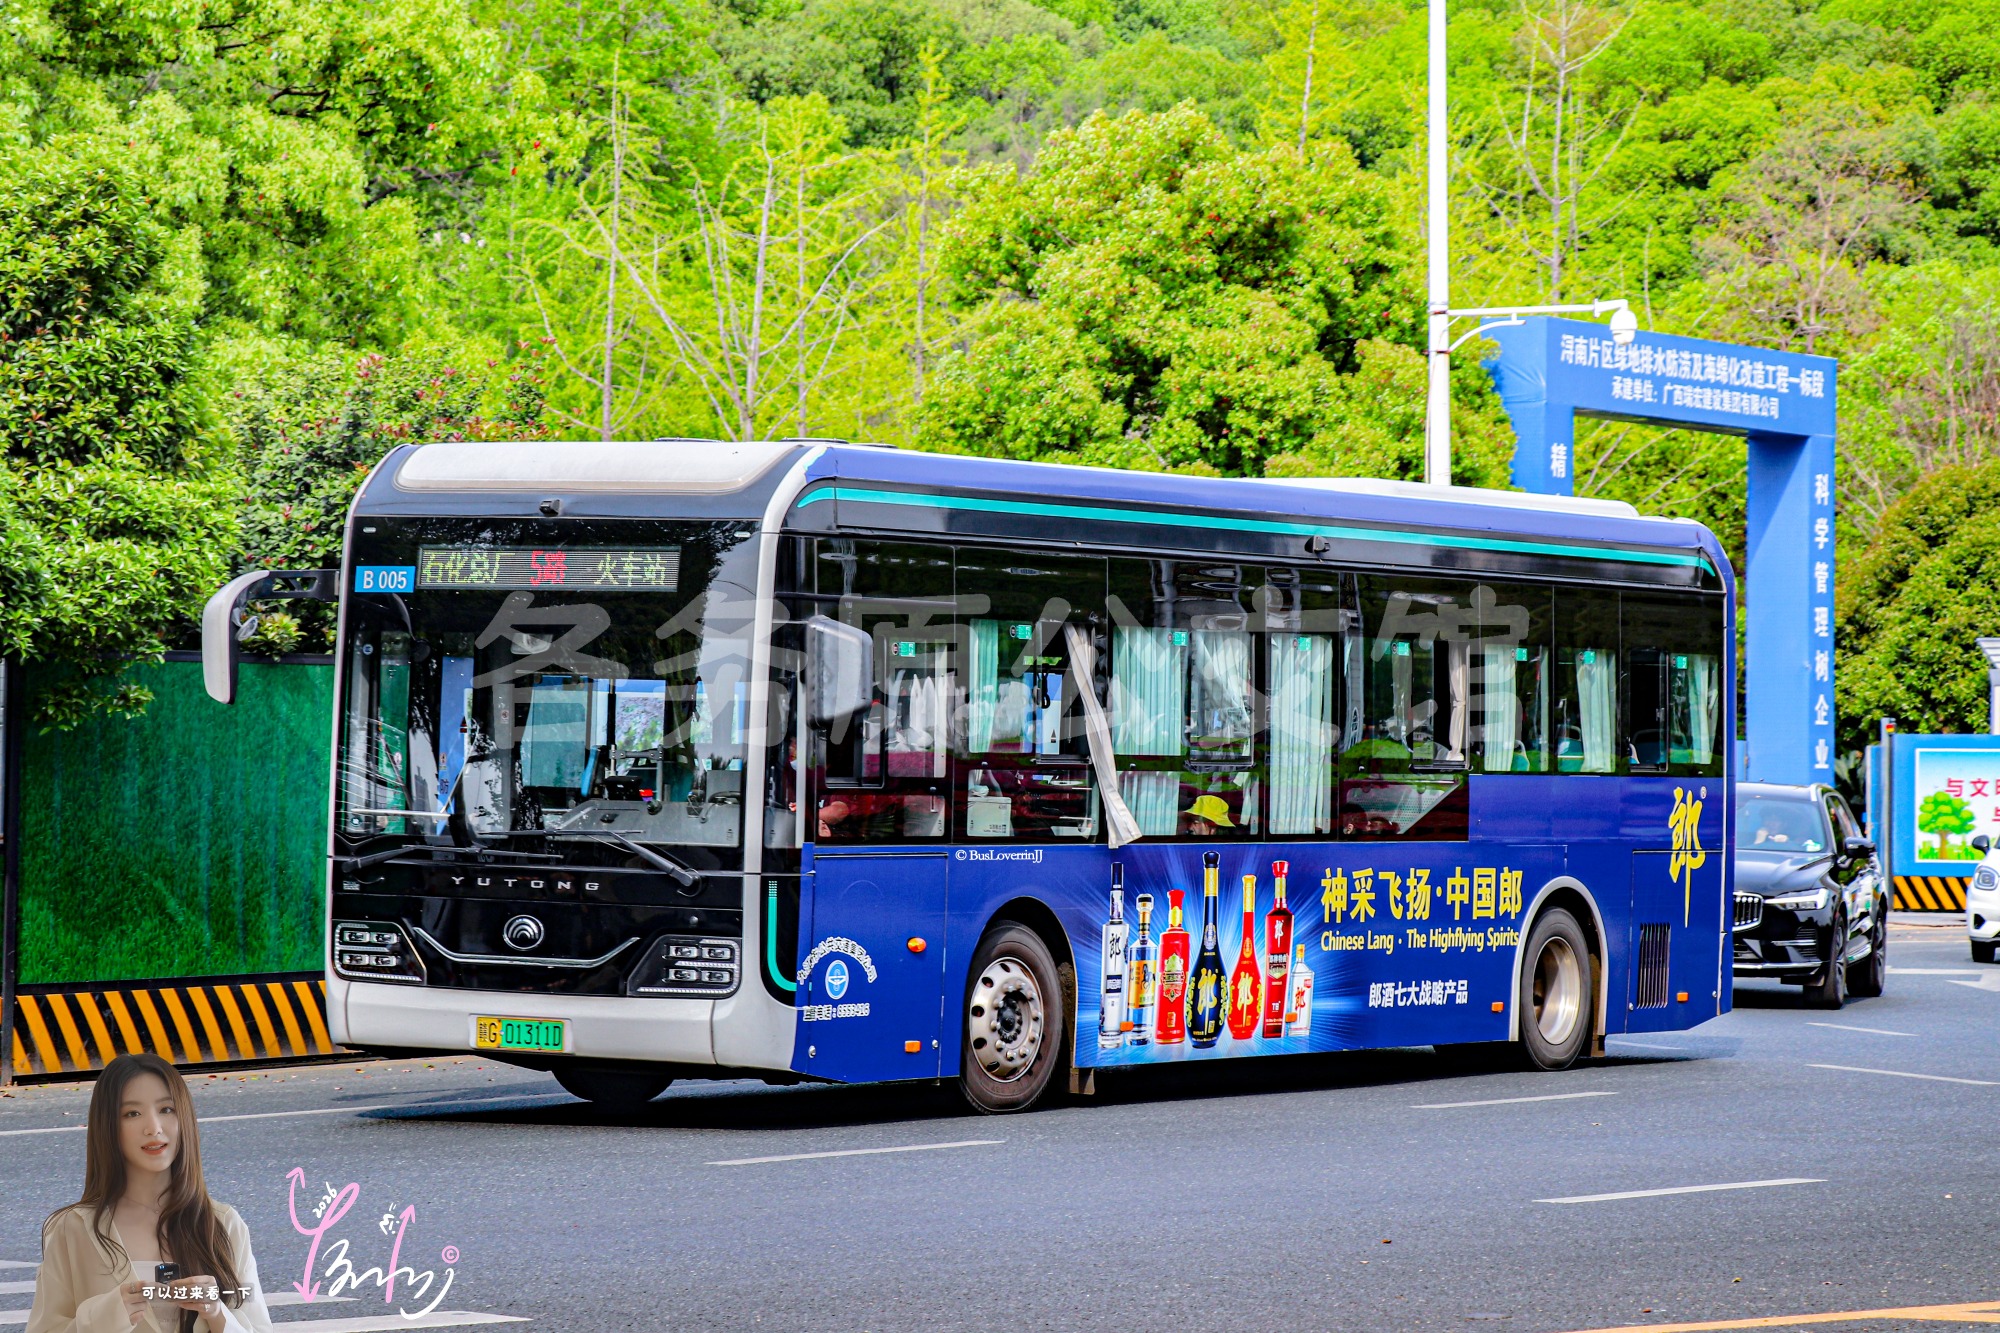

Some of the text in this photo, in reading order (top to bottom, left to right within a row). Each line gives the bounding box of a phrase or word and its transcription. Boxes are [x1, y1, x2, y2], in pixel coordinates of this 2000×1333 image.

[363, 570, 407, 589] B 005
[594, 552, 667, 587] 火车站
[1814, 473, 1830, 770] 科学管理树企业
[451, 876, 600, 891] YUTONG
[1320, 866, 1523, 924] 神采飞扬·中国郎
[1321, 926, 1519, 954] Chinese Lang The Highflying Spirits
[1368, 979, 1469, 1009] 郎酒七大战略产品
